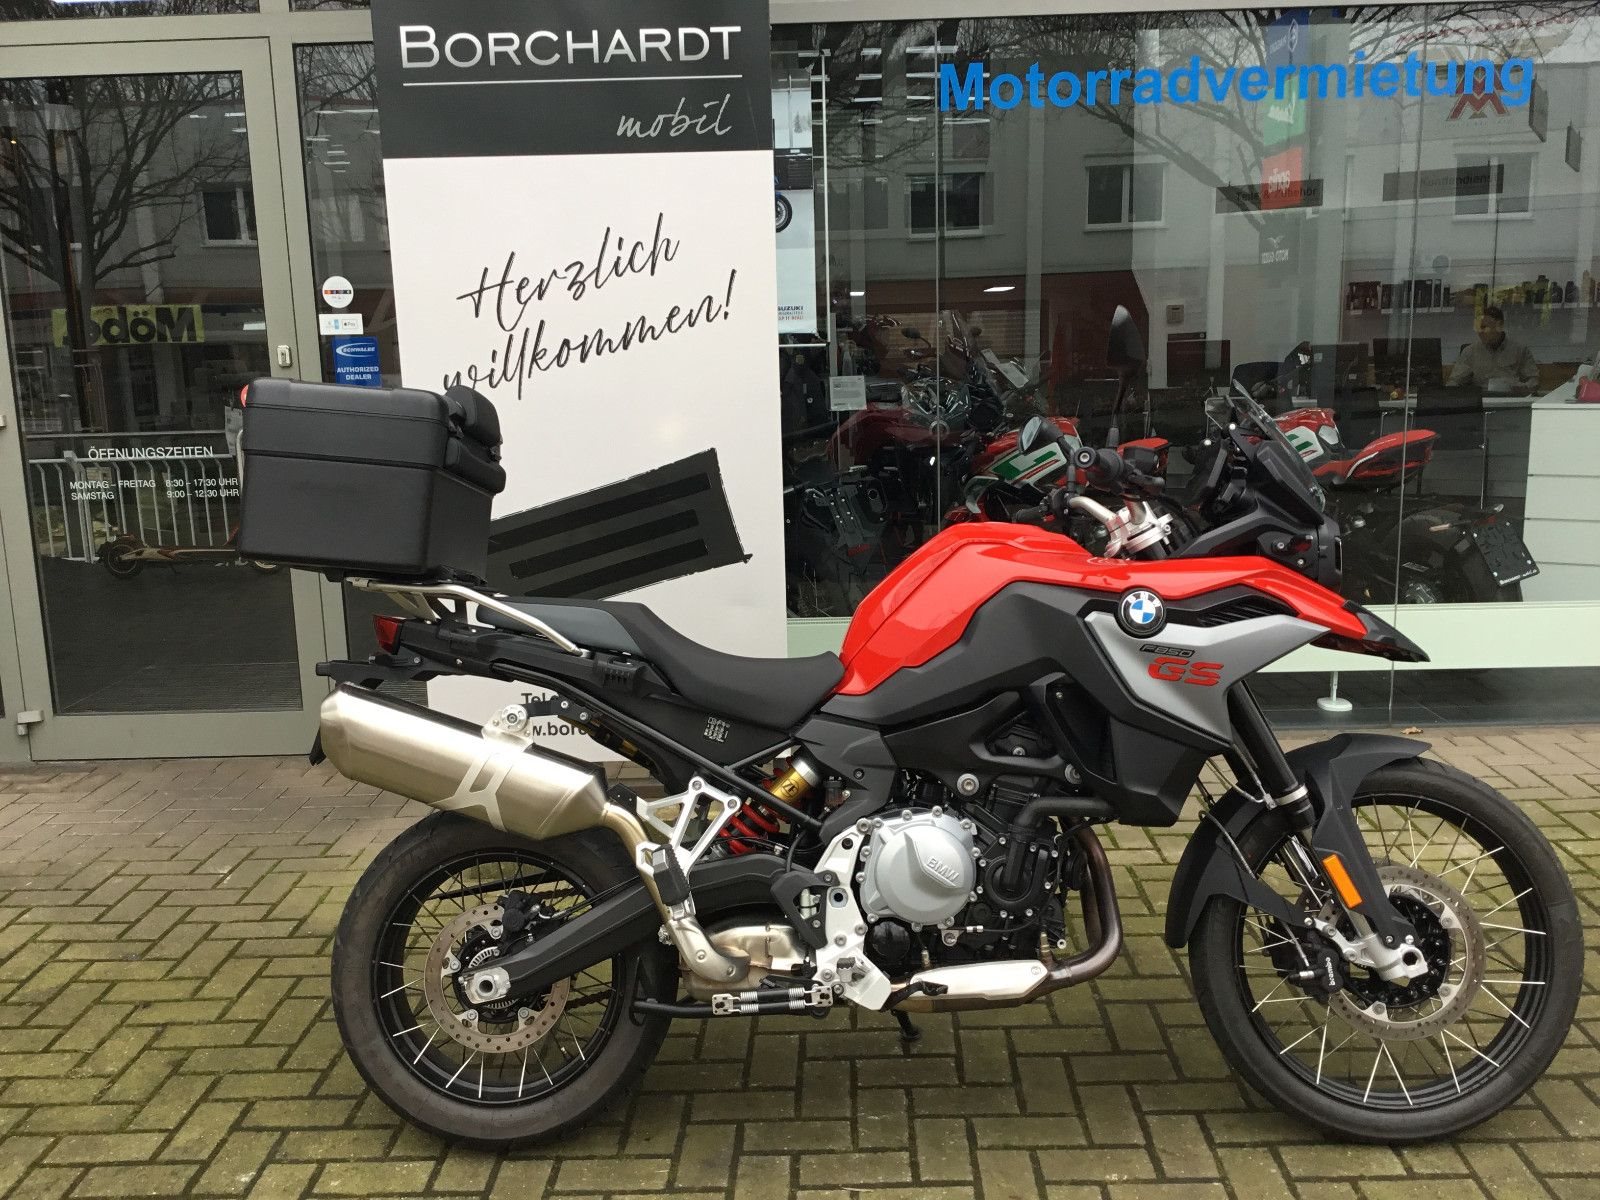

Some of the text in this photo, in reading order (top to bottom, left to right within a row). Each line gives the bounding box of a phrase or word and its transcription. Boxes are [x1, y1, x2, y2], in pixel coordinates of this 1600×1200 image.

[400, 25, 742, 68] BORCHARDT
[940, 50, 1534, 112] Motorradvermietung
[617, 93, 732, 138] mobil
[456, 212, 681, 332] Herzlich
[443, 269, 738, 400] willkommen!
[337, 366, 379, 374] AUTHORIZED
[88, 446, 214, 461] ÖFFNUNGSZEITEN
[69, 480, 109, 490] MONTAG
[118, 479, 156, 488] FREITAG
[165, 479, 184, 487] 8:30
[194, 478, 217, 487] 17:30
[218, 477, 239, 486] UHR
[71, 491, 115, 501] SAMSTAG
[166, 490, 186, 498] 9:00
[195, 489, 218, 498] 12:30
[219, 488, 240, 497] UHR
[1147, 656, 1224, 687] GS
[926, 857, 960, 882] BMW
[1325, 956, 1336, 986] brembo
